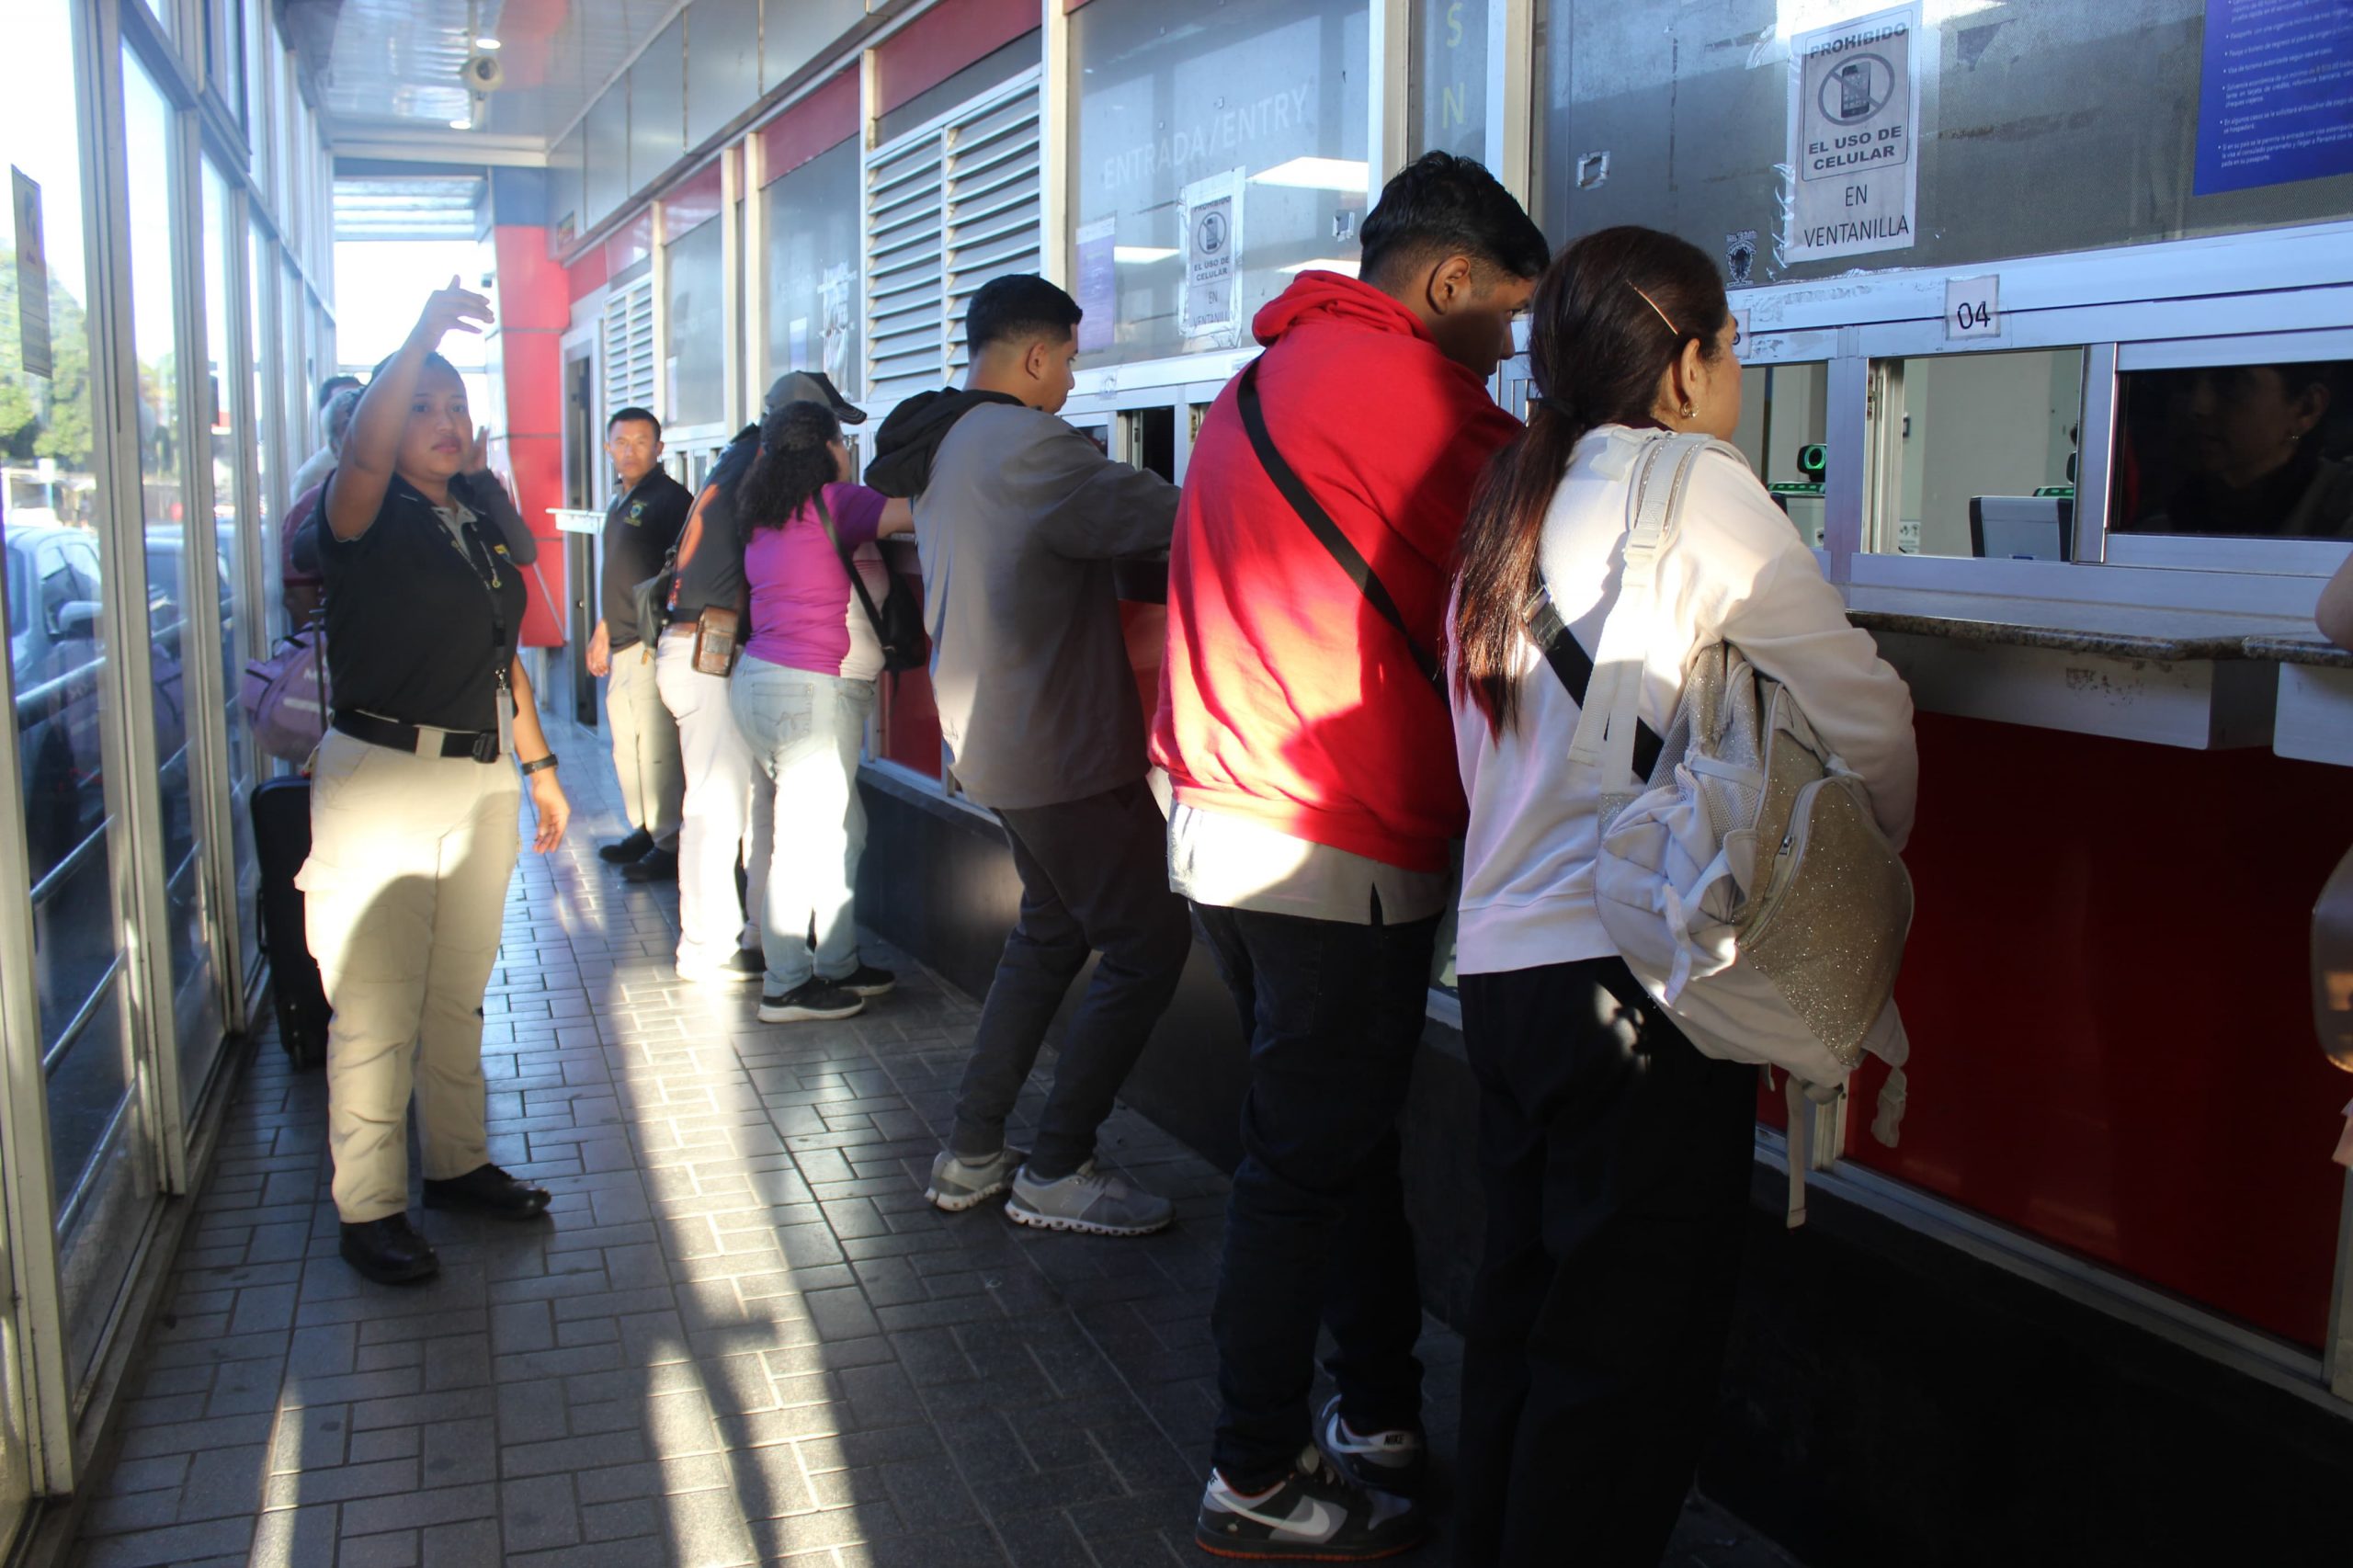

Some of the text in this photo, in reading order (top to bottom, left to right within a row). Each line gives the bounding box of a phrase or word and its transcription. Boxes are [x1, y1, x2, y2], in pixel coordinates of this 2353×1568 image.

[1810, 22, 1906, 59] PROHIBIDO
[1104, 84, 1307, 189] ENTRADA/ENTRY
[1809, 126, 1902, 155] EL USO DE
[1813, 145, 1895, 170] CELULAR
[1845, 184, 1868, 207] EN
[1804, 214, 1909, 248] VENTANILLA
[1196, 267, 1228, 281] CELULAR
[1204, 259, 1219, 269] USO
[1220, 256, 1230, 266] DE
[1209, 291, 1218, 305] EN
[1957, 301, 1991, 329] 04
[1383, 1434, 1404, 1446] NIKE
